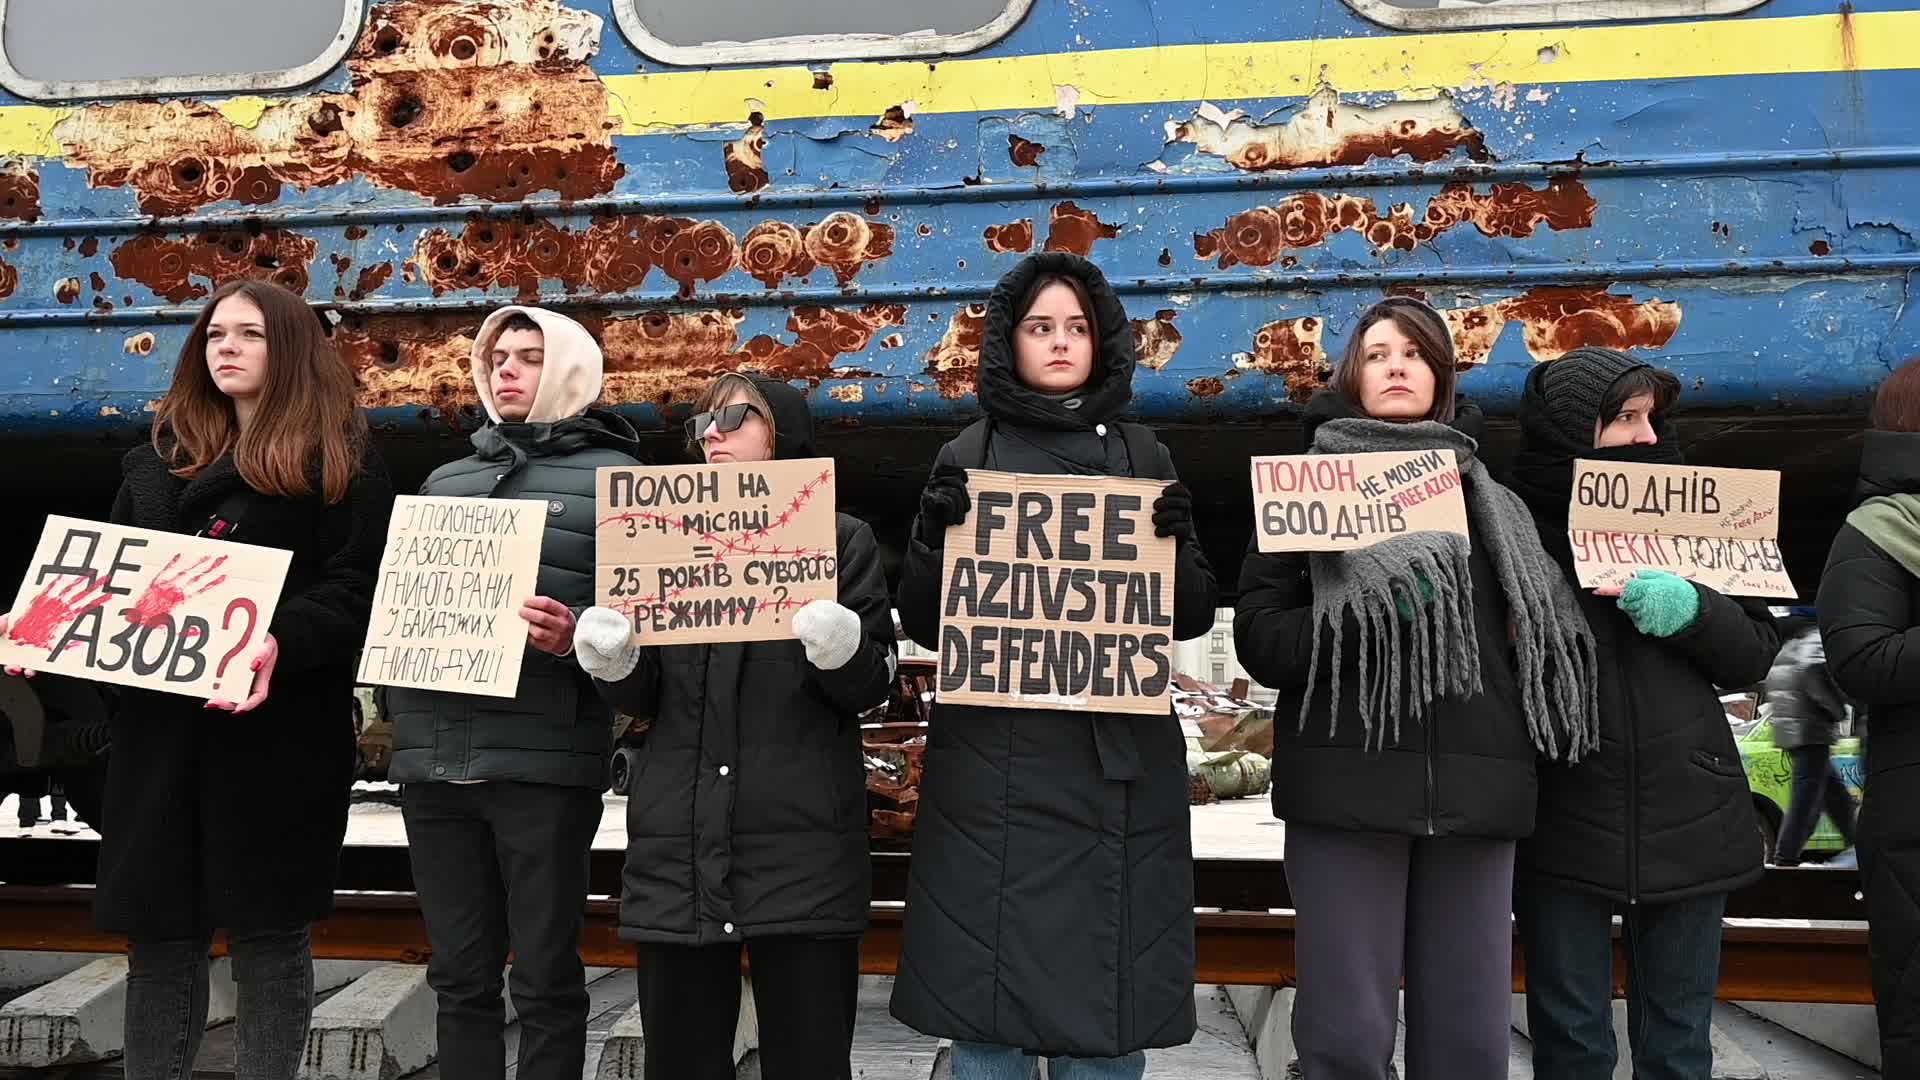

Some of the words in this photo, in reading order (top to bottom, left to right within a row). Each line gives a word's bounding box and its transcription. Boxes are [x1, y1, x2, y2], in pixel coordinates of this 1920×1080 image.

[610, 471, 719, 507] ПОЛОН
[738, 472, 770, 498] НА
[1256, 460, 1356, 493] ПОЛОН
[1357, 475, 1386, 500] НЕ
[1383, 450, 1446, 489] МОВЧИ
[1390, 485, 1427, 508] FREE
[1423, 468, 1461, 498] AZOV
[1578, 472, 1629, 509] 600
[1632, 471, 1721, 517] ДНІВ
[419, 504, 521, 535] ПОЛОНЕНИХ
[975, 491, 1141, 561] FREE
[1262, 501, 1328, 535] 600
[1331, 499, 1407, 540] ДНІВ
[35, 528, 149, 595] ДЕ
[403, 536, 503, 568] АЗОВСТАЛІ
[381, 571, 454, 606] ГНИЮТЬ
[457, 571, 513, 609] РАНИ
[609, 567, 640, 597] 25
[944, 557, 1171, 627] AZOVSTAL
[401, 607, 497, 639] БАЙДУЖИХ
[634, 596, 757, 634] РЕЖИМУ
[363, 646, 441, 683] ГНИЮТЬ
[940, 625, 1171, 697] DEFENDERS
